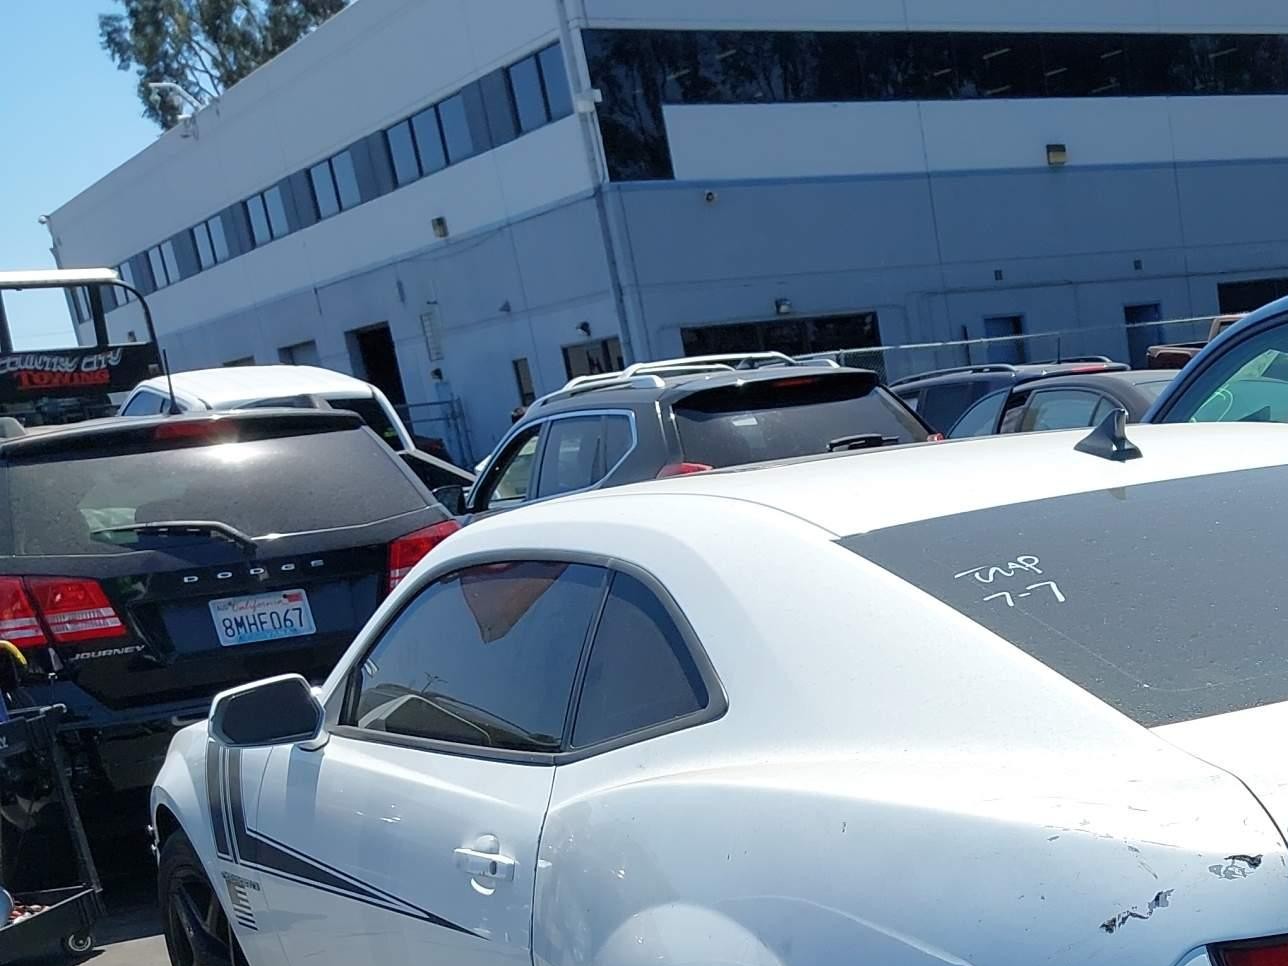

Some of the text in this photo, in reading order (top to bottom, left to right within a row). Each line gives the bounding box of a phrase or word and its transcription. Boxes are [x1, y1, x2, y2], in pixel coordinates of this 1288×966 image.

[18, 369, 109, 388] TOWING
[183, 559, 325, 583] DODGE
[983, 581, 1066, 607] 7-7
[222, 607, 304, 638] 8MHF067
[69, 644, 146, 661] JOURNEY
